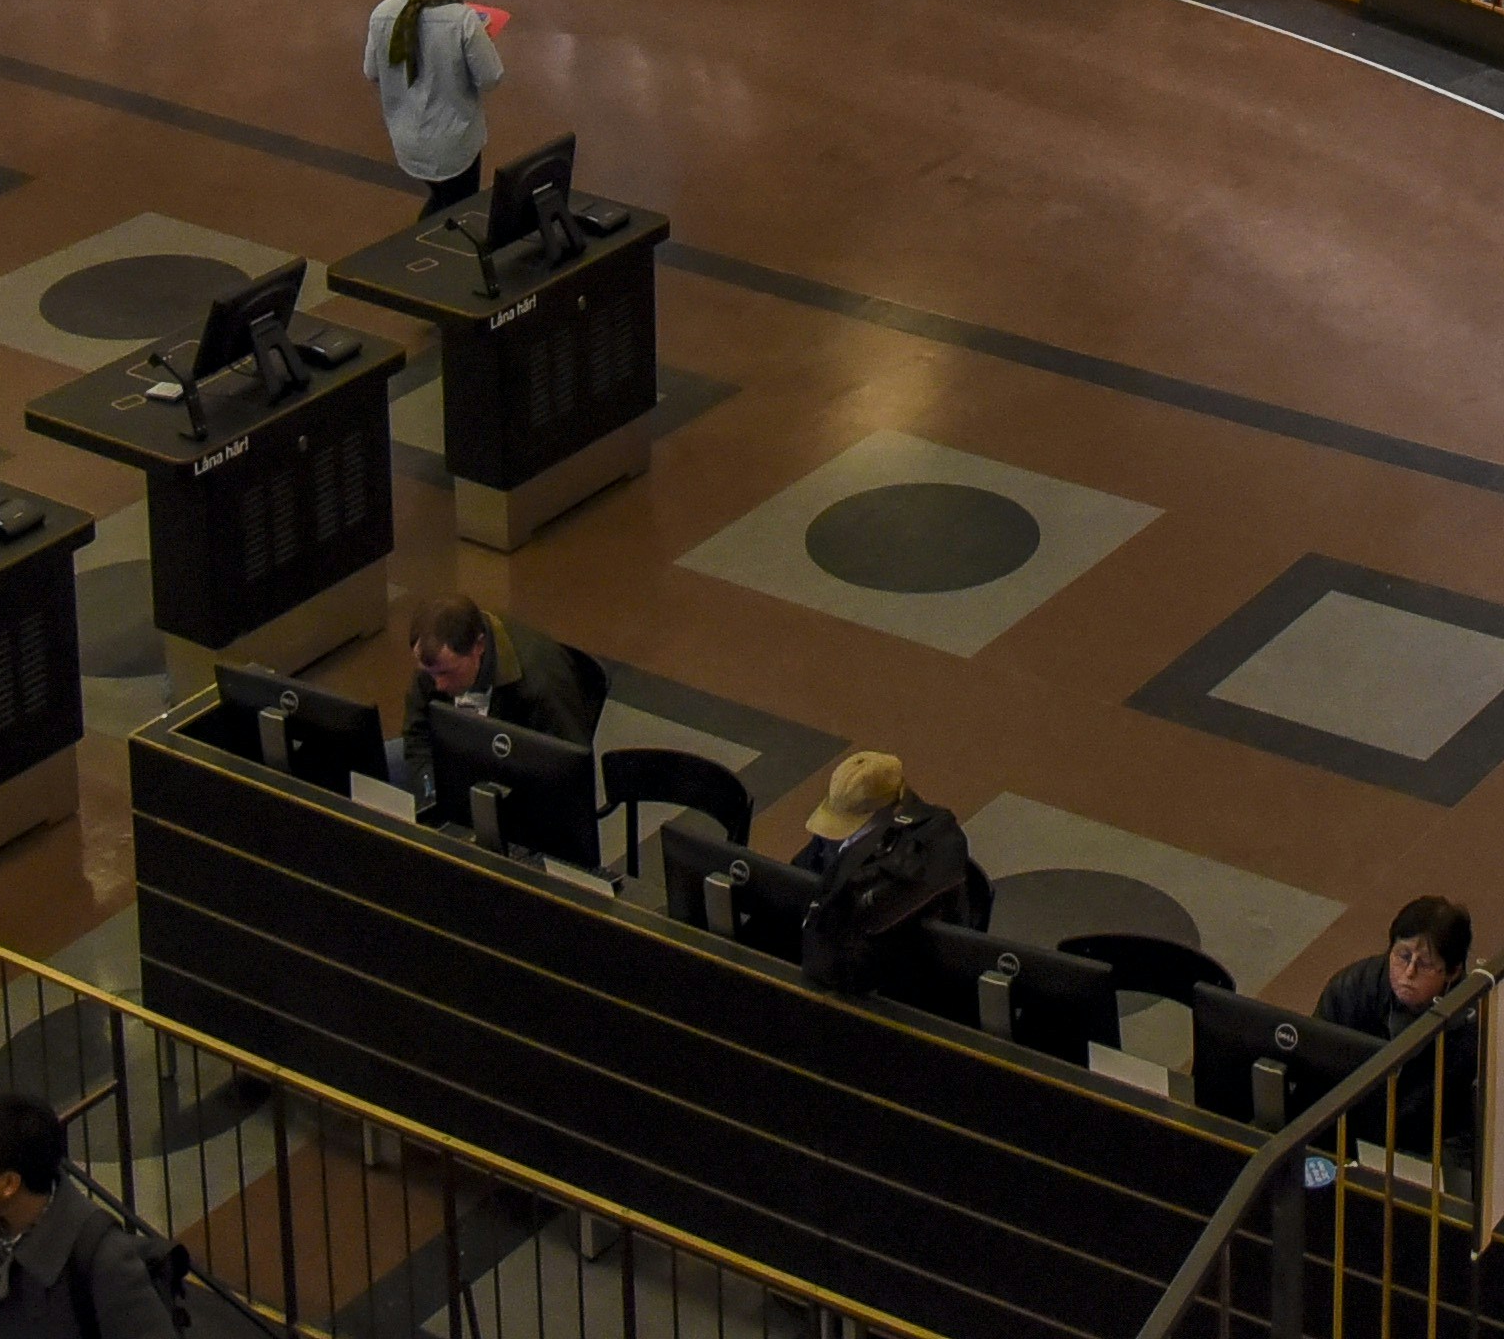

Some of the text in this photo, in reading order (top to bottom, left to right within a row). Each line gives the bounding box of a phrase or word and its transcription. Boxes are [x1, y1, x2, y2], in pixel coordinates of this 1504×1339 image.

[490, 294, 537, 330] Låna här!
[194, 435, 249, 476] Låna här!
